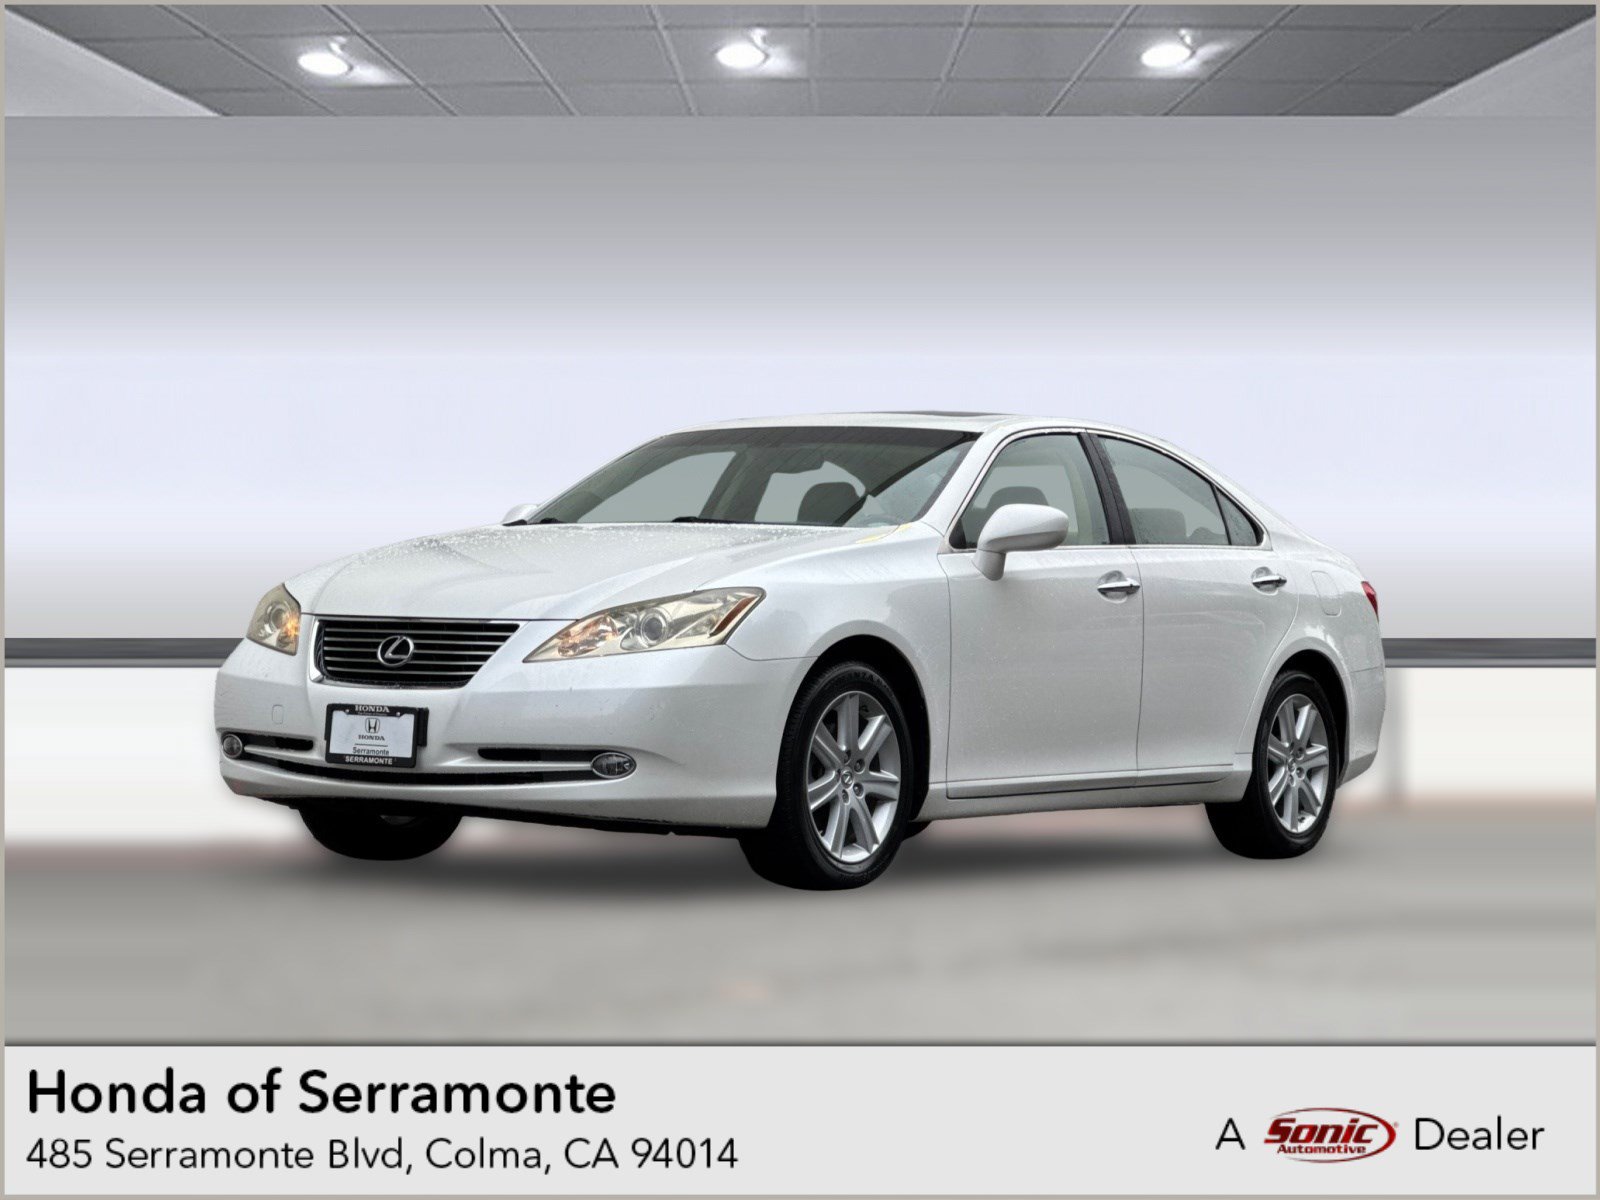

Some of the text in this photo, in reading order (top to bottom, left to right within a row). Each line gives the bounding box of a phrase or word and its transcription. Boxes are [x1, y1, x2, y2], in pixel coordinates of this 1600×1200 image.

[355, 705, 390, 713] HONDA
[353, 747, 389, 756] Serramonte
[345, 756, 393, 765] SERRAMONTE
